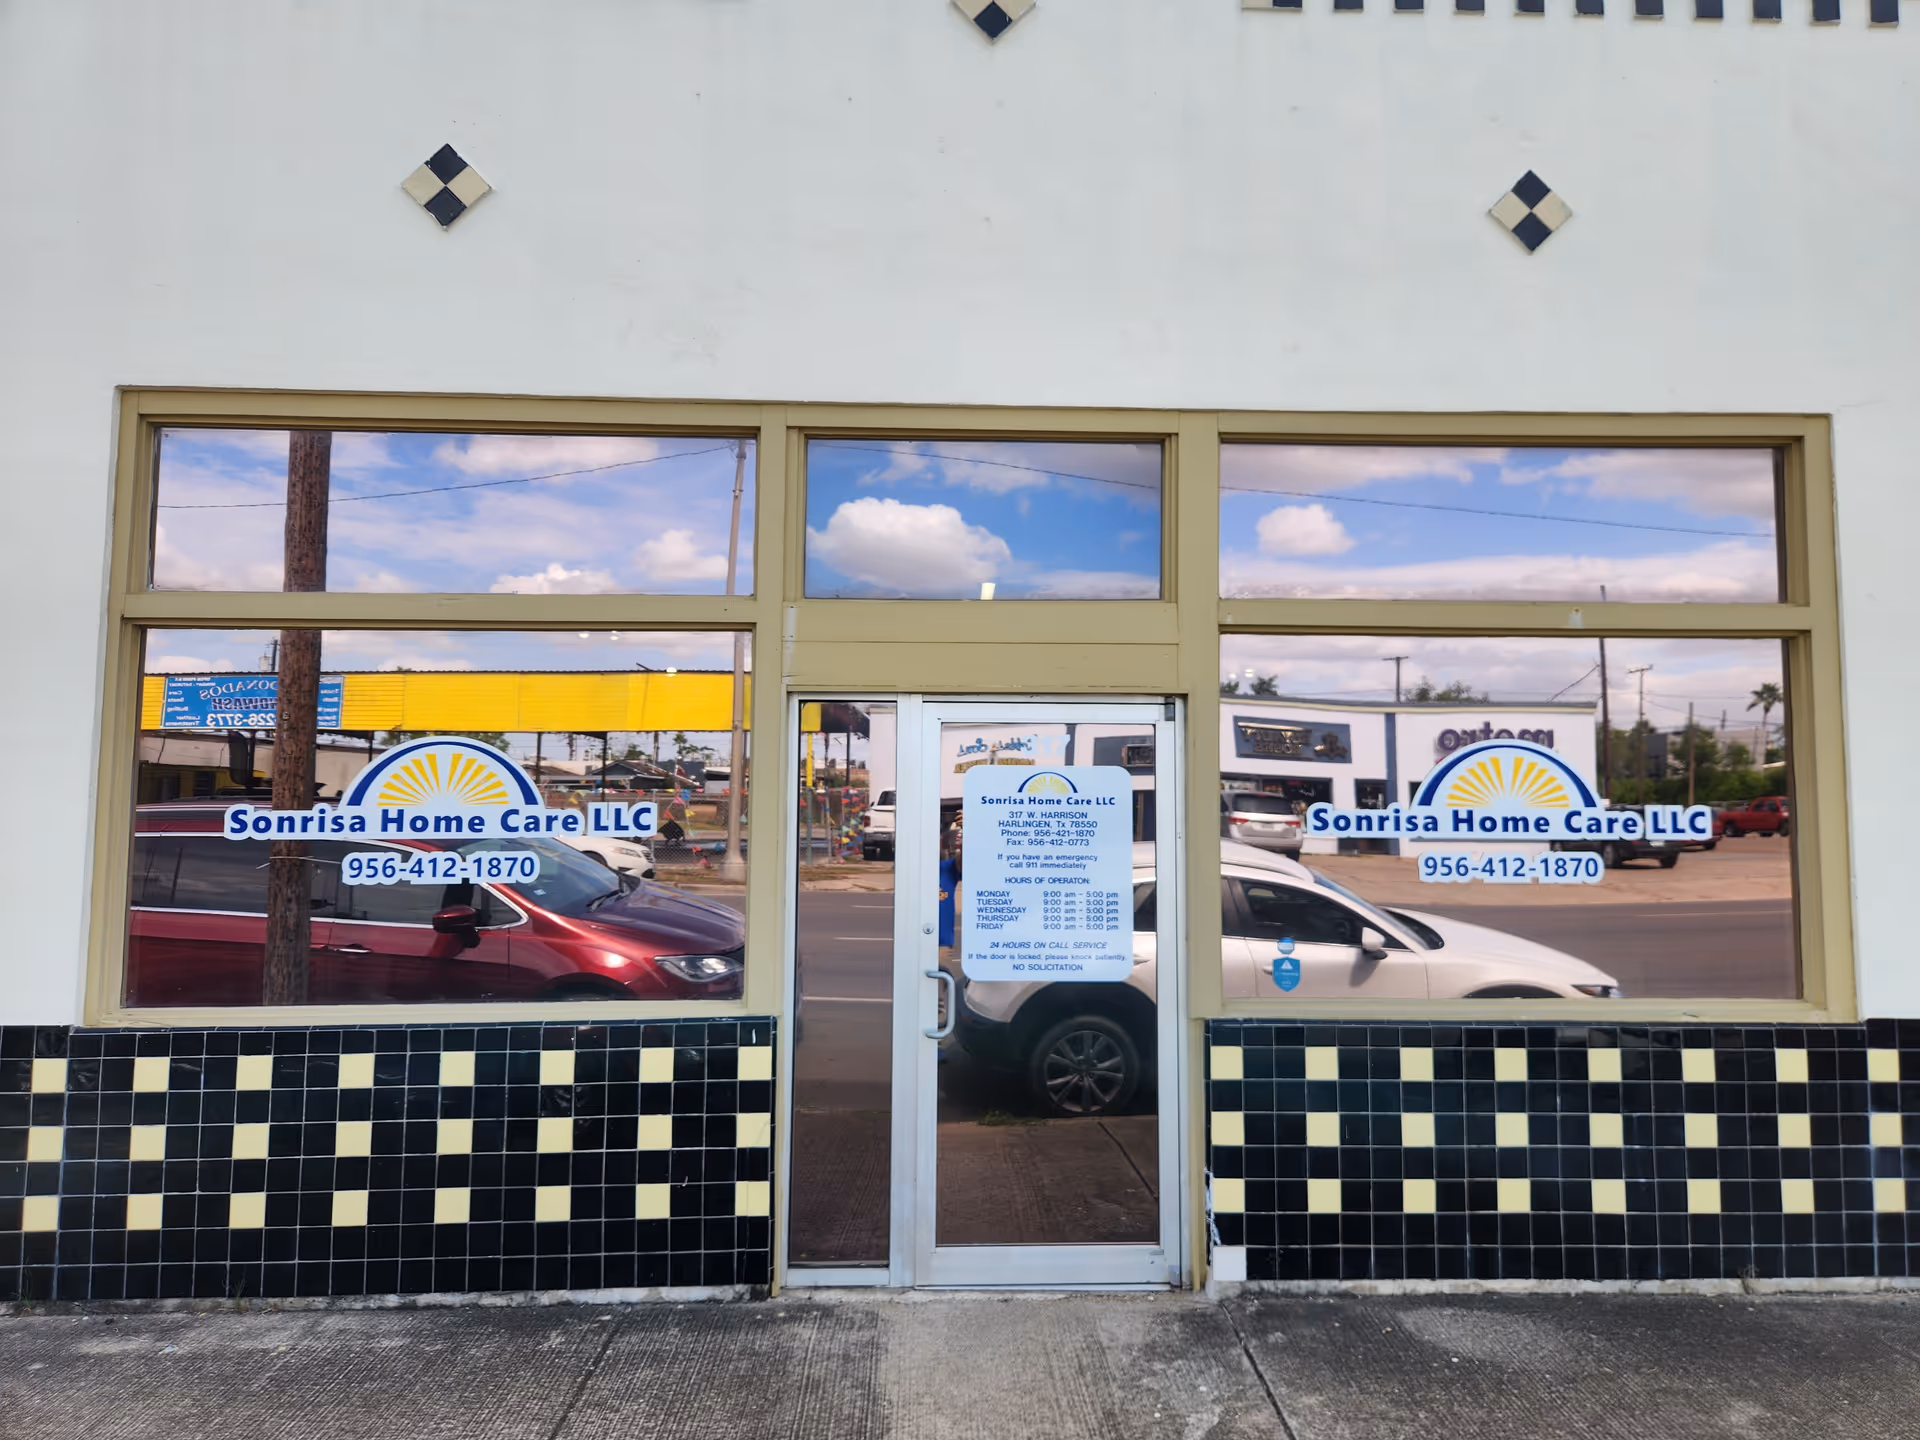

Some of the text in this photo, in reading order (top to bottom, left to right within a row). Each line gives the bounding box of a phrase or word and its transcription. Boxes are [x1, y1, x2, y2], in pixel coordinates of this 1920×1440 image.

[980, 796, 1116, 805] Sonrisa Home Care LLC
[229, 806, 652, 834] Sonrisa Home Care LLC
[1008, 811, 1088, 820] 317 W. HARRISON
[998, 820, 1098, 829] HARLINGEN, Tx 78550
[1312, 808, 1708, 833] Sonrisa Home Care LLC
[1000, 829, 1096, 837] Phone: 956-421-1870
[1006, 838, 1090, 846] Fax: 956-412-0773
[997, 853, 1004, 861] If
[1006, 854, 1021, 862] you
[1022, 853, 1041, 861] have
[1055, 854, 1098, 862] emergency
[348, 856, 536, 879] 956-412-1870
[1009, 861, 1087, 870] call 911 immediately
[1423, 857, 1599, 878] 956-412-1870
[1004, 877, 1033, 885] HOURS
[1034, 877, 1046, 885] OF
[976, 890, 1011, 898] MONDAY
[1042, 890, 1062, 898] 9:00
[1085, 891, 1104, 899] 5:00
[1105, 892, 1119, 900] pm
[976, 898, 1014, 906] TUESDAY
[1042, 898, 1062, 906] 9:00
[1085, 899, 1105, 907] 5:00
[1105, 900, 1119, 908] pm
[976, 906, 1027, 914] WEDNESDAY
[1042, 906, 1062, 914] 9:00
[1085, 907, 1105, 915] 5:00
[1105, 908, 1119, 916] pm
[976, 914, 1020, 922] THURSDAY
[1042, 915, 1062, 923] 9:00
[1085, 915, 1105, 923] 5:00
[1106, 916, 1119, 924] pm
[975, 922, 1005, 930] FRIDAY
[1042, 923, 1062, 931] 9:00
[1085, 923, 1105, 931] 5:00
[1105, 924, 1119, 932] pm
[989, 941, 1108, 950] 24 HOURS ON CALL SERVICE
[1012, 963, 1084, 972] NO SOLICITATION
